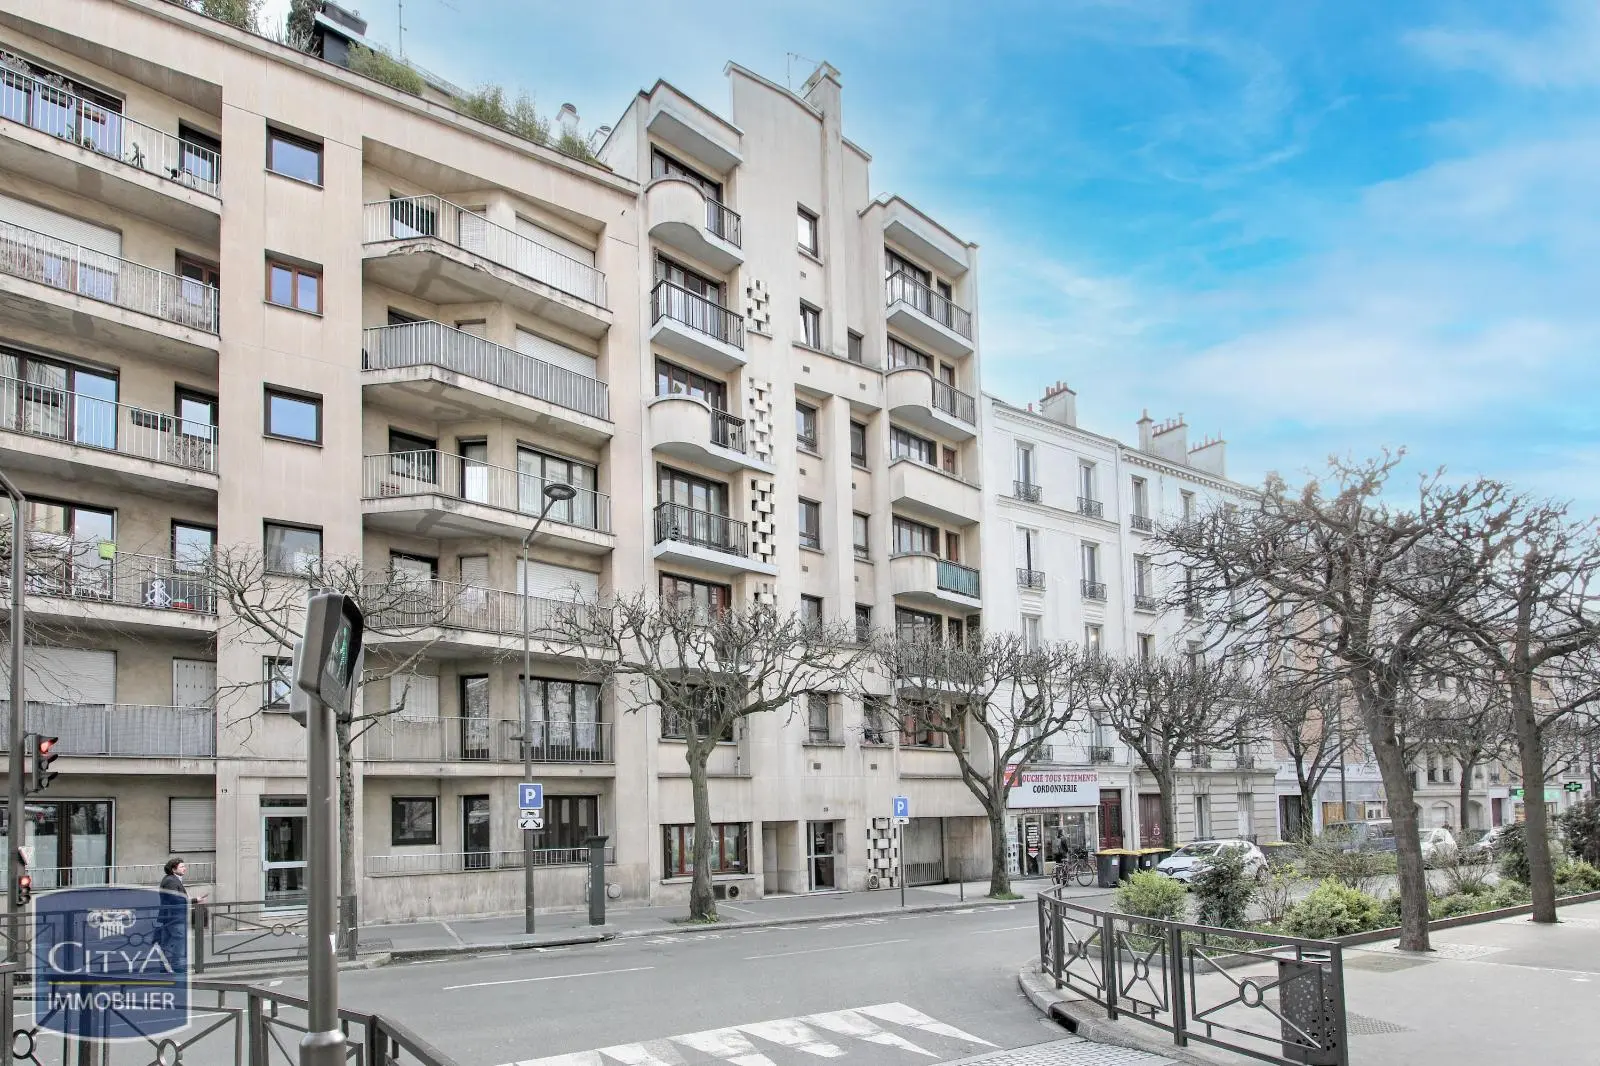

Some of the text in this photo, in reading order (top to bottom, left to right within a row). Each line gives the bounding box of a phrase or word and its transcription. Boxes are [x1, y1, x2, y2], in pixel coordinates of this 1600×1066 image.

[1022, 774, 1043, 782] OUCHE
[1045, 774, 1061, 782] TOUS
[1032, 784, 1077, 793] CORDONNERIE
[526, 788, 536, 804] P
[898, 801, 904, 813] P
